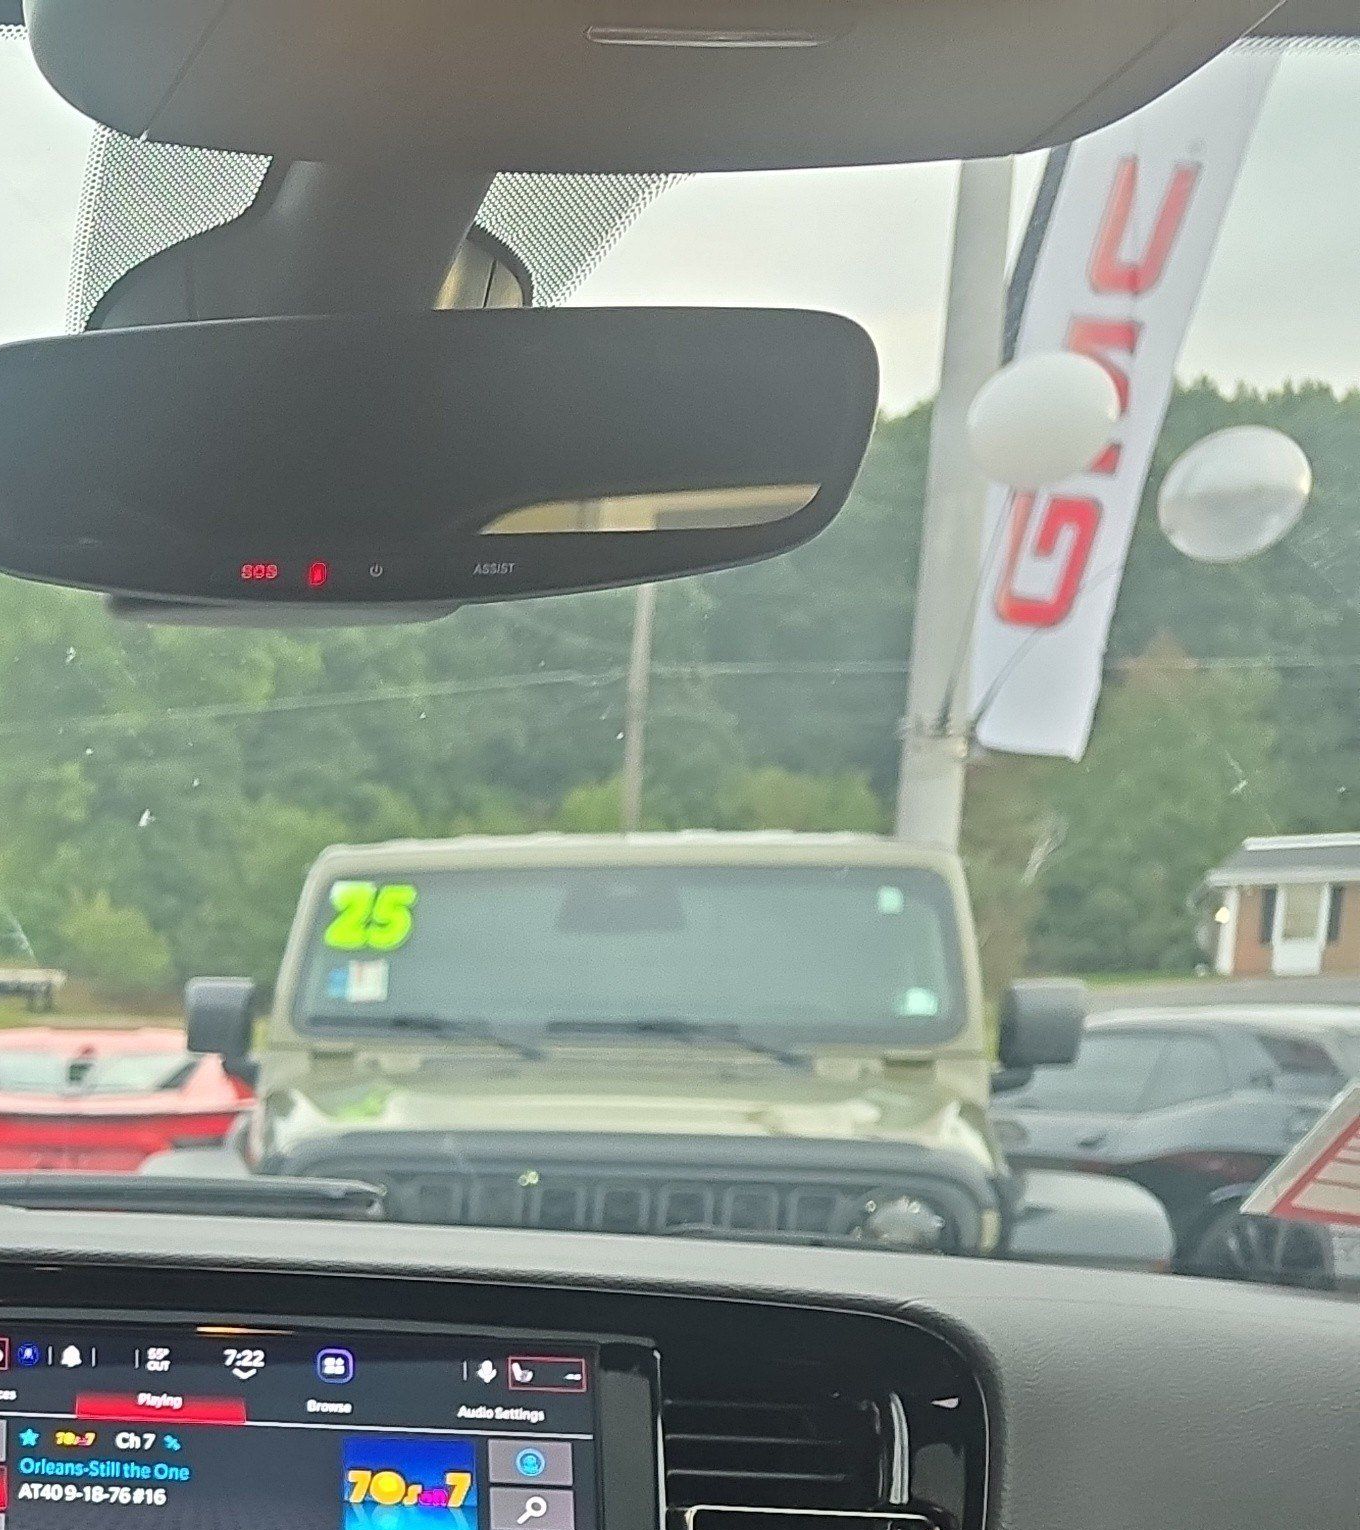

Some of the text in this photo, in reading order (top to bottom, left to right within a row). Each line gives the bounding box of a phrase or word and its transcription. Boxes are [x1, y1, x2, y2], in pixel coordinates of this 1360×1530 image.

[241, 564, 278, 579] SOS
[473, 562, 516, 575] ASSIST
[323, 880, 417, 952] 25
[224, 1349, 265, 1367] 7:22
[137, 1393, 183, 1409] Playing
[307, 1399, 352, 1415] Browse
[457, 1405, 546, 1423] Audio Settings
[115, 1431, 156, 1450] Ch 7
[19, 1457, 190, 1481] Orleans-Still the One
[18, 1483, 64, 1500] AT40
[132, 1487, 167, 1505] #16
